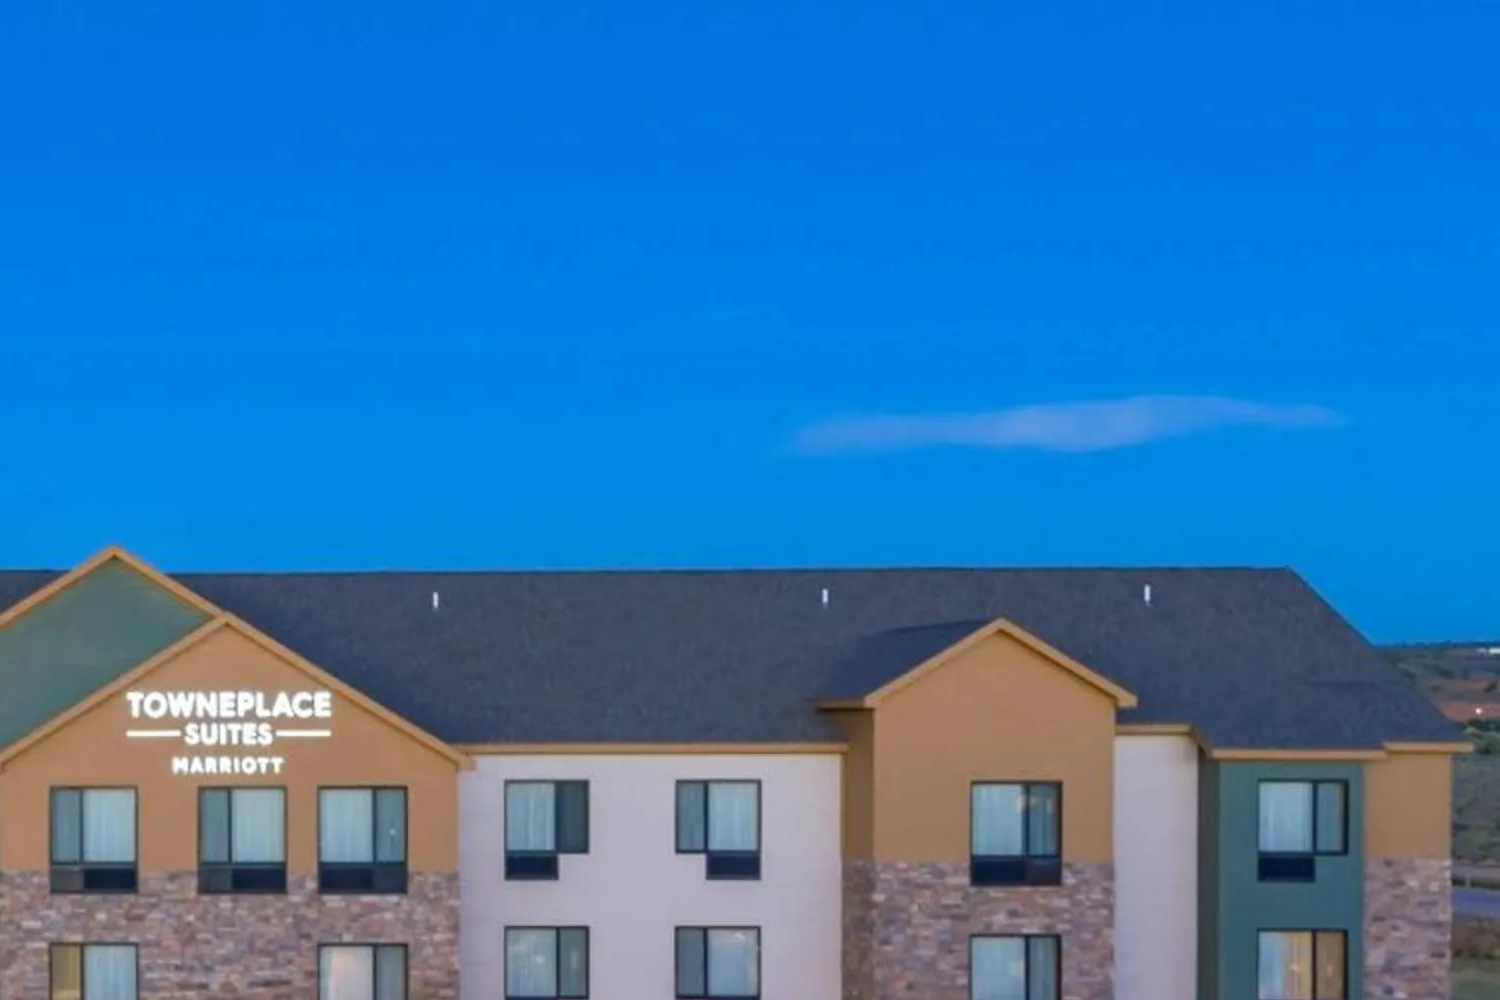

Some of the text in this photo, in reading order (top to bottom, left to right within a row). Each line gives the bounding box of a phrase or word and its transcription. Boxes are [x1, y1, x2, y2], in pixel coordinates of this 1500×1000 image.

[126, 691, 332, 718] TOWNEPLACE
[184, 722, 273, 745] SUITES
[171, 756, 284, 775] MARRIOTT
